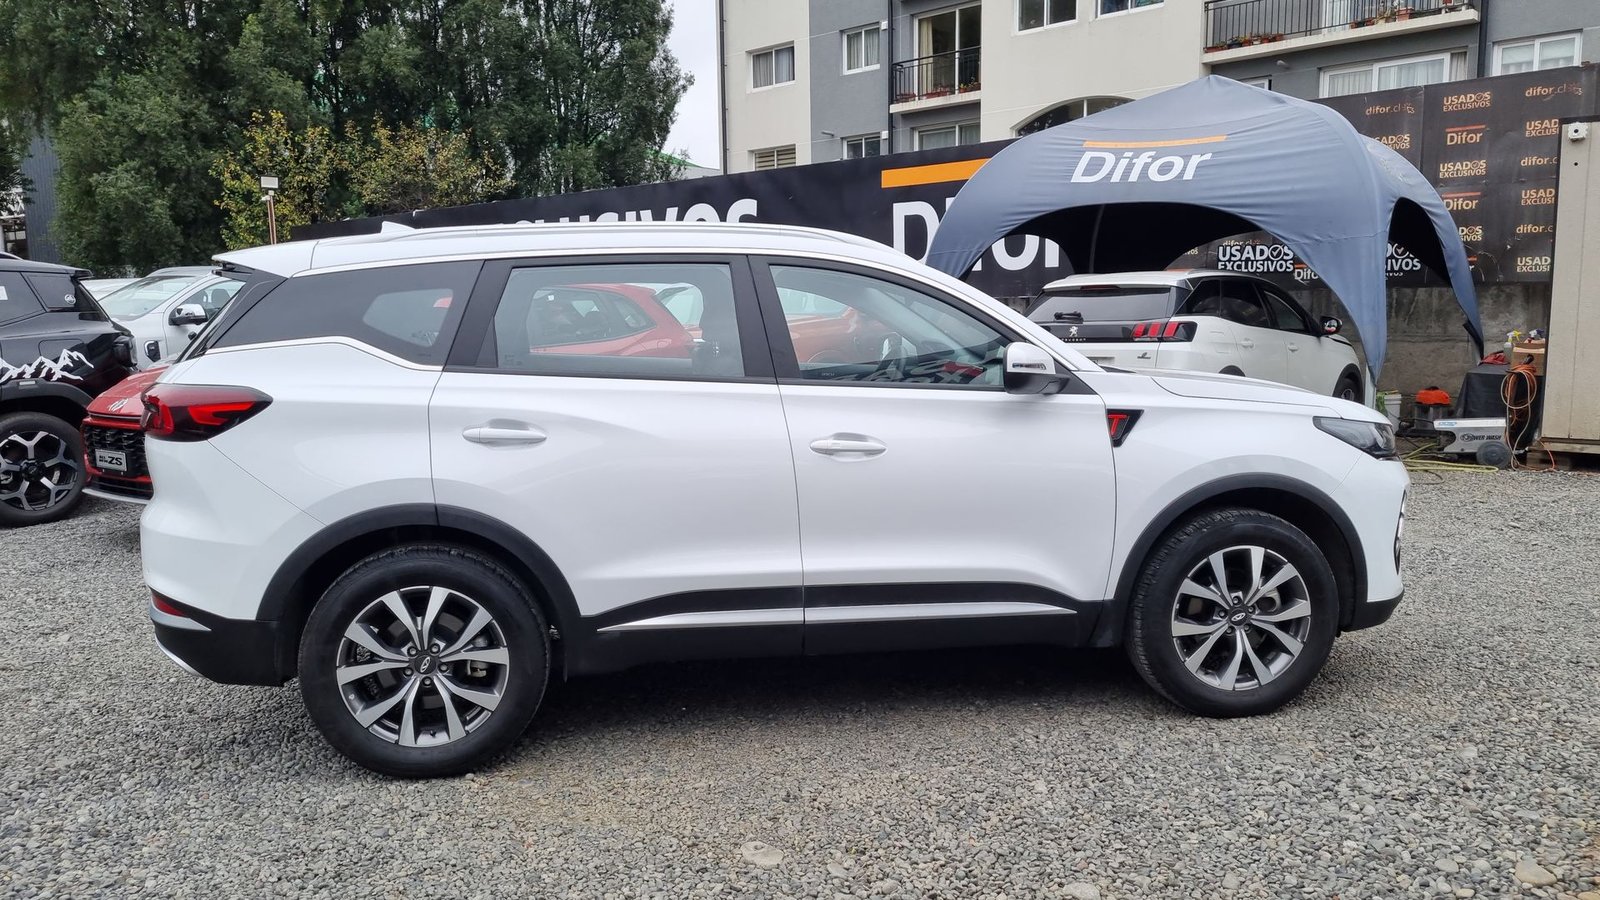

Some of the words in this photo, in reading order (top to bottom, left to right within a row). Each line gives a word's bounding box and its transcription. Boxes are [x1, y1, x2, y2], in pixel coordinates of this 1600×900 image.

[1443, 91, 1491, 106] USADOS
[1442, 100, 1491, 112] EXCLUSIVOS
[1526, 118, 1560, 131] USAD
[1447, 131, 1483, 146] Difor
[1525, 128, 1560, 138] EXCLUSI
[1374, 134, 1410, 145] ADOS
[1070, 151, 1213, 183] Difor
[1439, 160, 1487, 172] USADOS
[1520, 156, 1558, 167] difor.c
[1439, 169, 1486, 179] EXCLUSIVOS
[1521, 188, 1556, 199] USAD
[1443, 198, 1479, 211] Difor
[1521, 197, 1555, 206] EXCLUSI
[1459, 225, 1483, 236] DOS
[1516, 224, 1553, 234] difor.c
[1218, 244, 1294, 261] USADOS
[1218, 260, 1294, 272] EXCLUSIVOS
[1517, 256, 1551, 266] USAD
[1294, 268, 1319, 280] Difo
[1516, 264, 1550, 273] EXCLUSI
[107, 456, 123, 466] ZS
